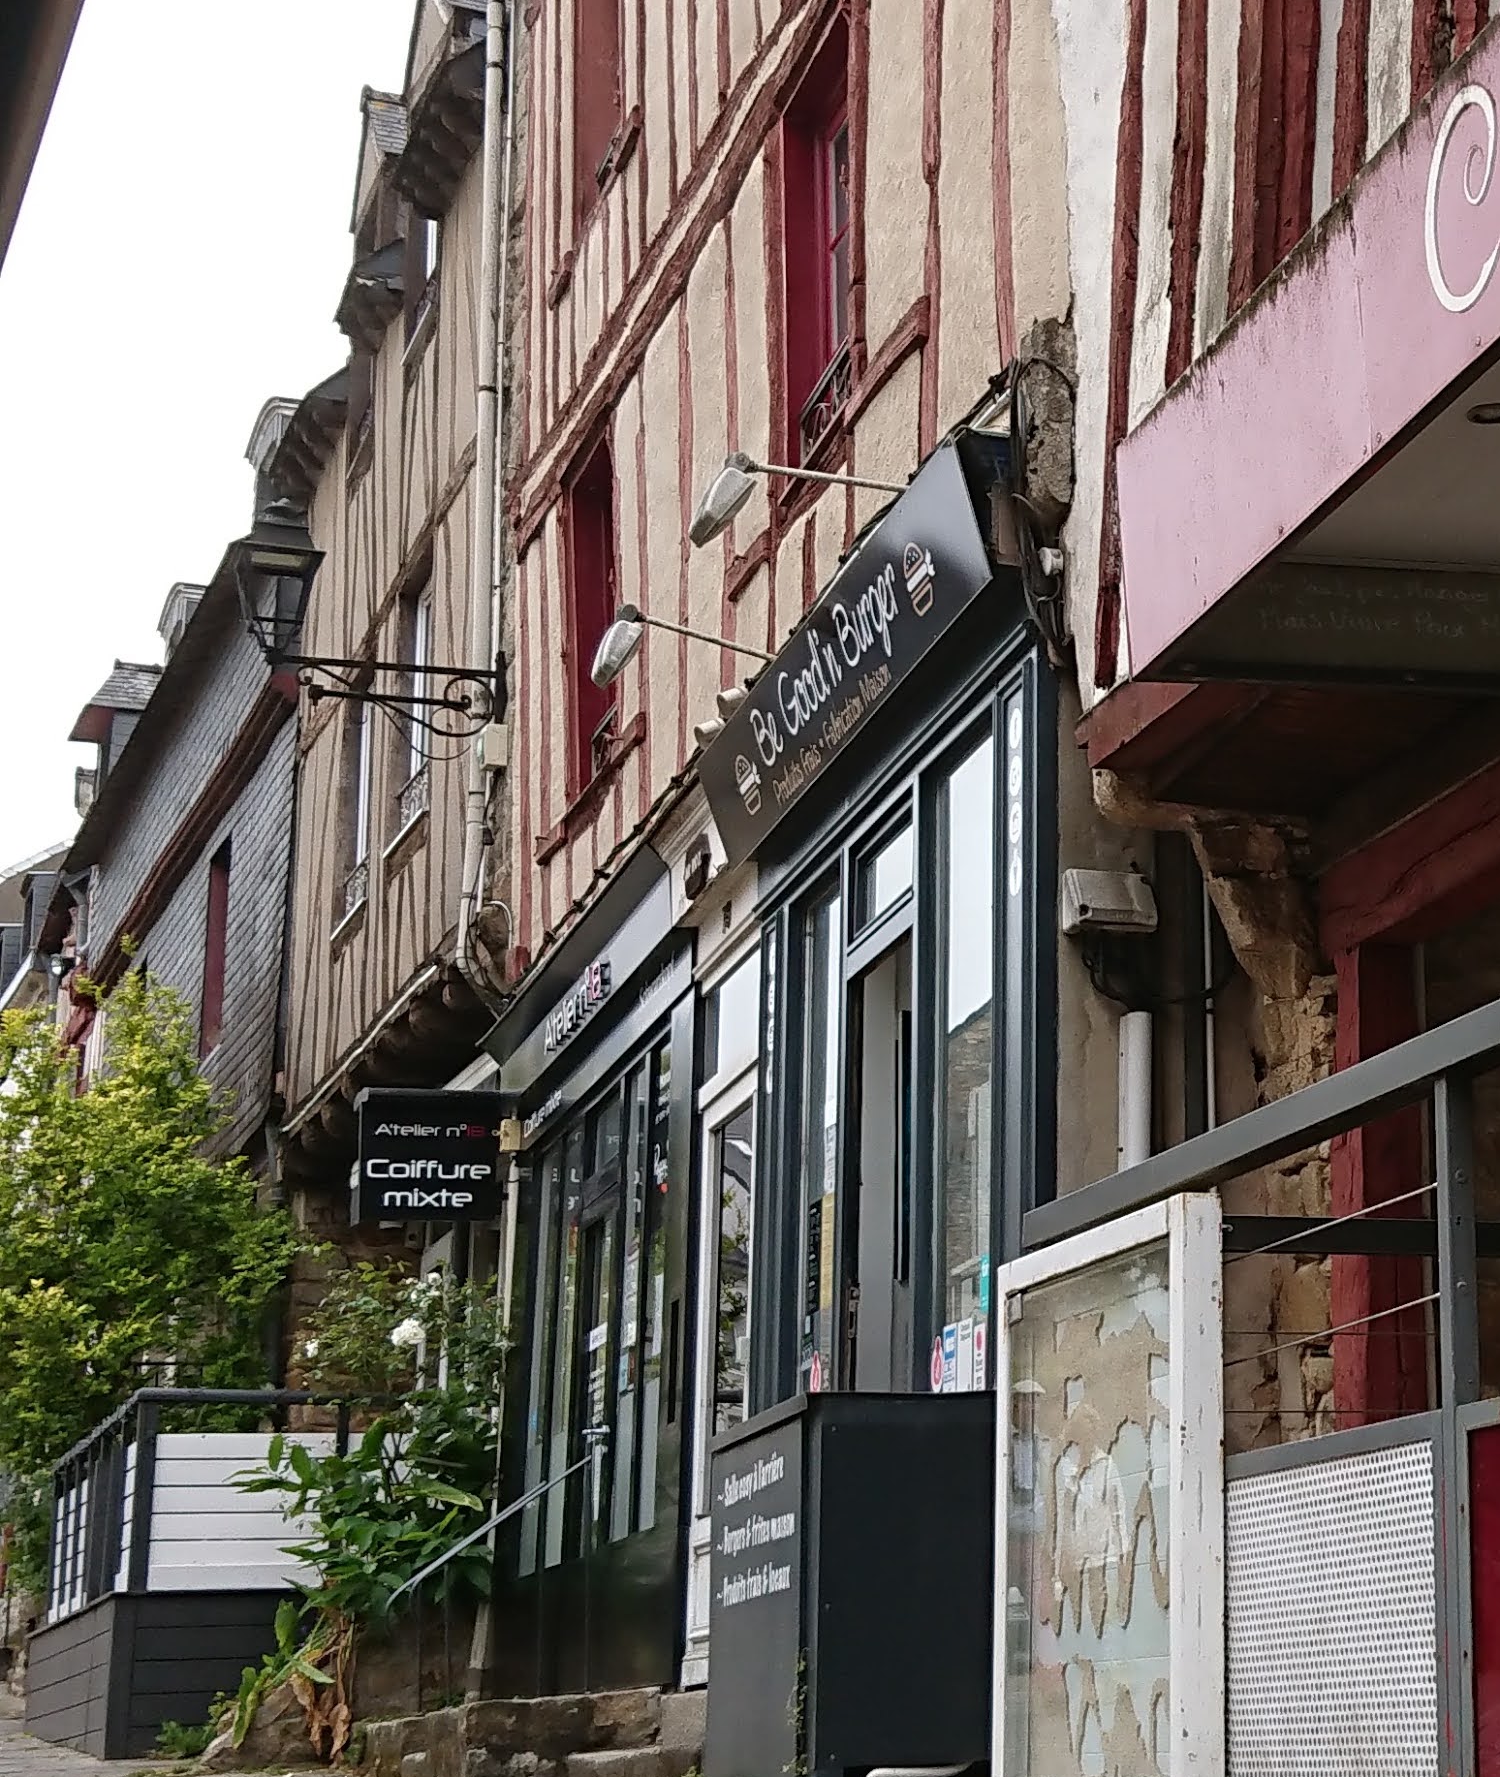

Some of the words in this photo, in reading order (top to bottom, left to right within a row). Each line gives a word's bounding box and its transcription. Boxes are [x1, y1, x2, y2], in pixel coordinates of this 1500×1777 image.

[750, 708, 784, 766] Be
[778, 628, 843, 736] Good'n
[832, 562, 899, 668] Burger
[772, 761, 804, 807] Produits
[800, 744, 823, 776] Frais
[822, 695, 864, 750] Fabrication
[859, 663, 892, 706] Maison
[366, 1158, 491, 1180] Coiffure
[383, 1188, 473, 1209] mixte
